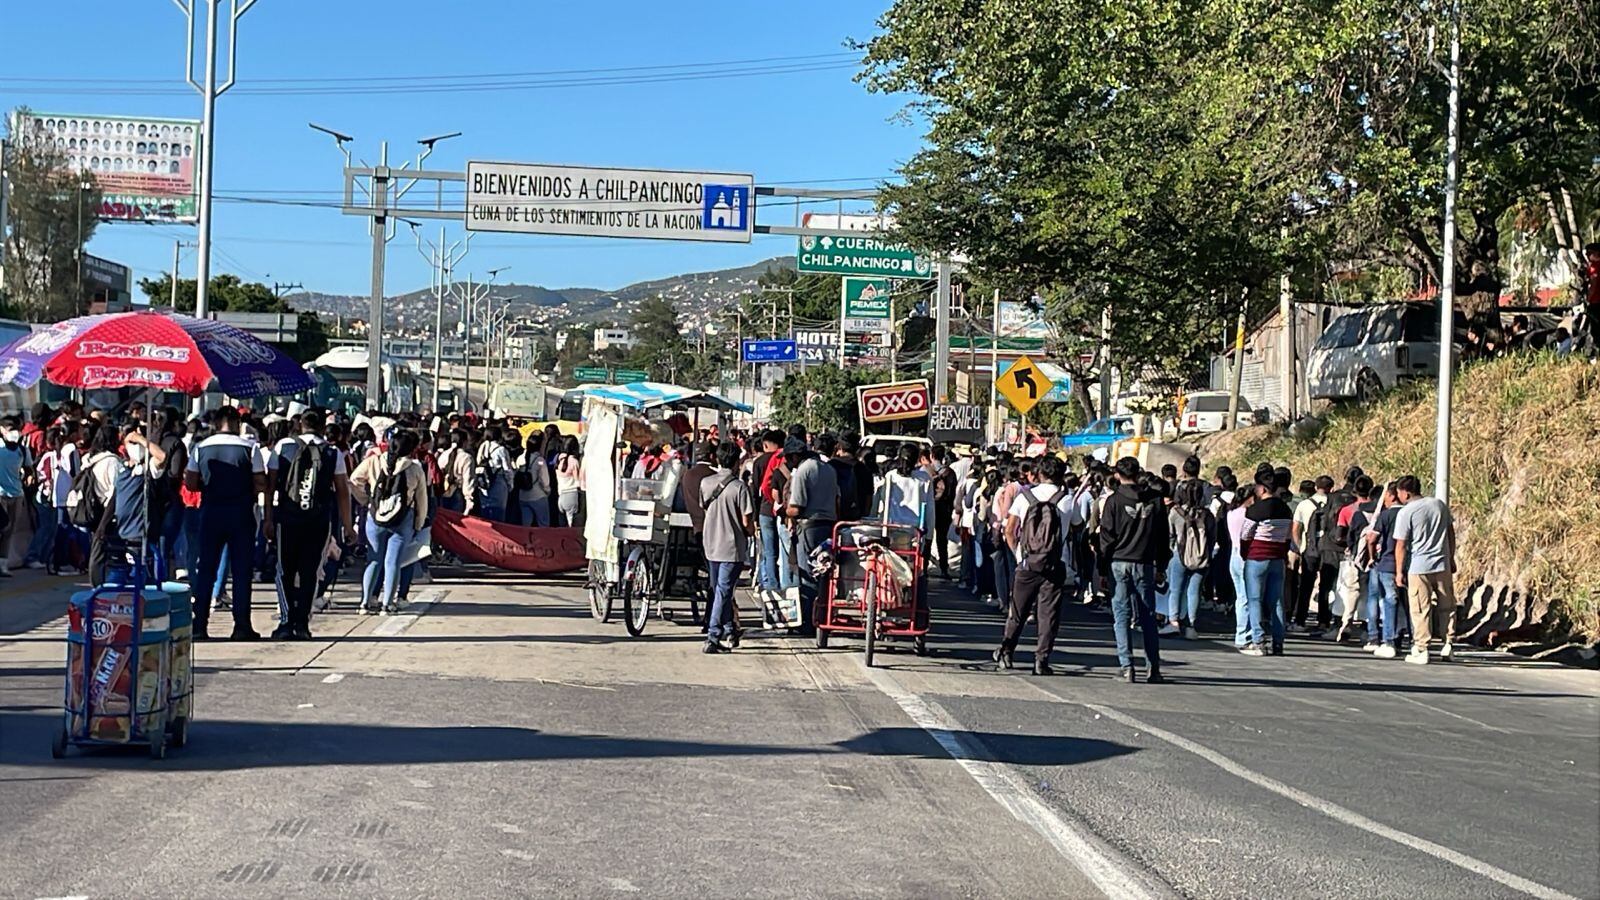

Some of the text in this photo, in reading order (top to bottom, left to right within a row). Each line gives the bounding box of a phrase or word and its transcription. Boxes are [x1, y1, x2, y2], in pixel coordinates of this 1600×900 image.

[474, 173, 703, 204] BIENVENIDOS A CHILPANCINGO
[473, 204, 702, 230] CUNA DE LOS SENTIMIENTOS DE LA NACION
[836, 238, 911, 253] CUERNAVA
[802, 254, 899, 270] CHILPANCINGO
[797, 332, 841, 345] HOTE
[867, 390, 923, 415] OXXO
[932, 405, 980, 418] SERVICIO
[930, 418, 980, 430] MECANICO
[299, 468, 313, 510] adidas
